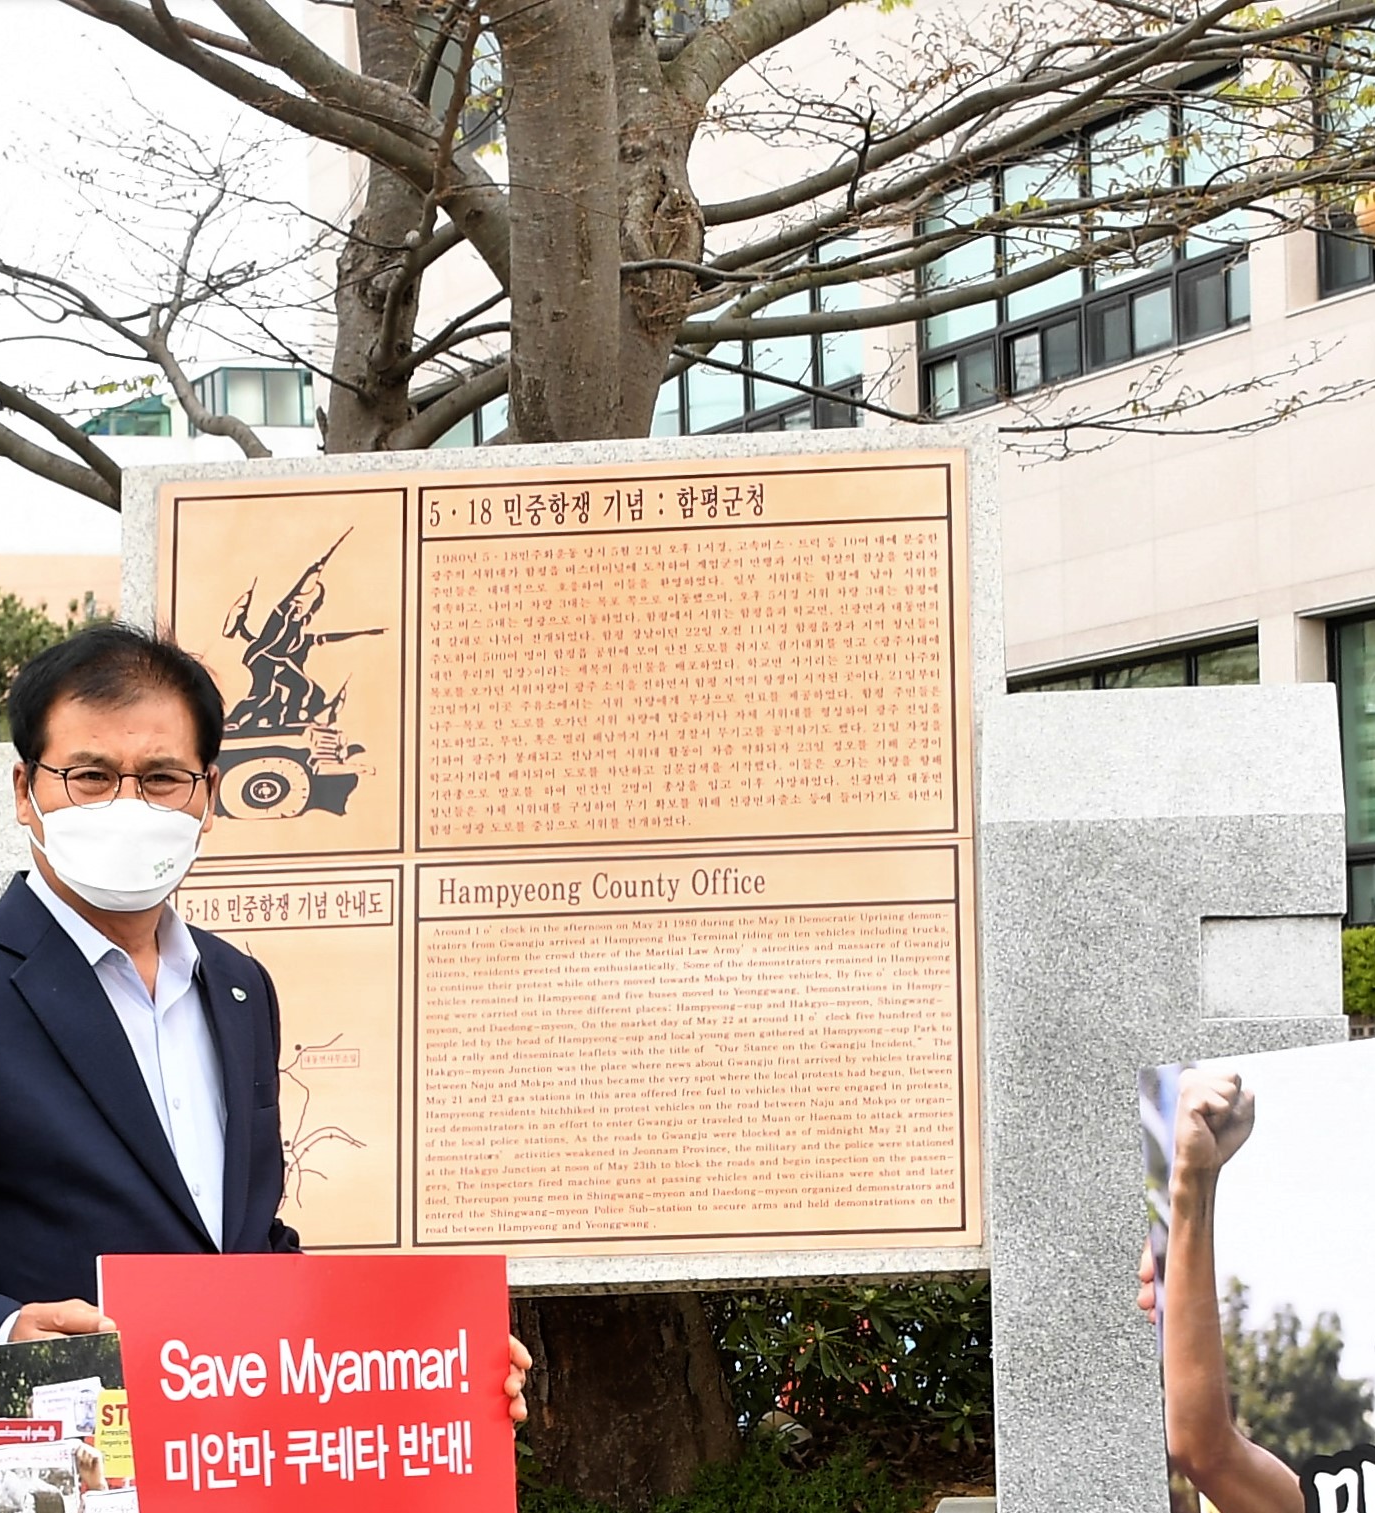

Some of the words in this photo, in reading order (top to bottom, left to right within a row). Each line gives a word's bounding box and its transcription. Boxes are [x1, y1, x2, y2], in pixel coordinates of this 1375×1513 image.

[503, 490, 590, 526] 민중항쟁
[603, 488, 643, 522] 기념
[676, 482, 765, 519] 함평군청
[438, 876, 582, 907] Hampyeong
[592, 870, 680, 902] County
[691, 867, 766, 896] Office
[227, 893, 290, 922] 민중항쟁
[298, 892, 328, 921] 기념
[336, 889, 384, 918] 안내도
[580, 1062, 596, 1071] the
[426, 1095, 446, 1106] May
[468, 1094, 486, 1103] and
[507, 1095, 524, 1103] gas
[456, 1180, 474, 1190] The
[752, 1171, 771, 1180] and
[776, 1171, 795, 1179] two
[905, 1167, 924, 1176] and
[468, 1209, 485, 1218] the
[783, 1199, 802, 1209] and
[938, 1195, 955, 1204] the
[160, 1339, 267, 1401] Save
[279, 1329, 469, 1404] Myanmar!
[102, 1404, 129, 1426] ST
[164, 1428, 276, 1491] 미얀마
[284, 1424, 390, 1485] 쿠테타
[398, 1420, 473, 1477] 반대!
